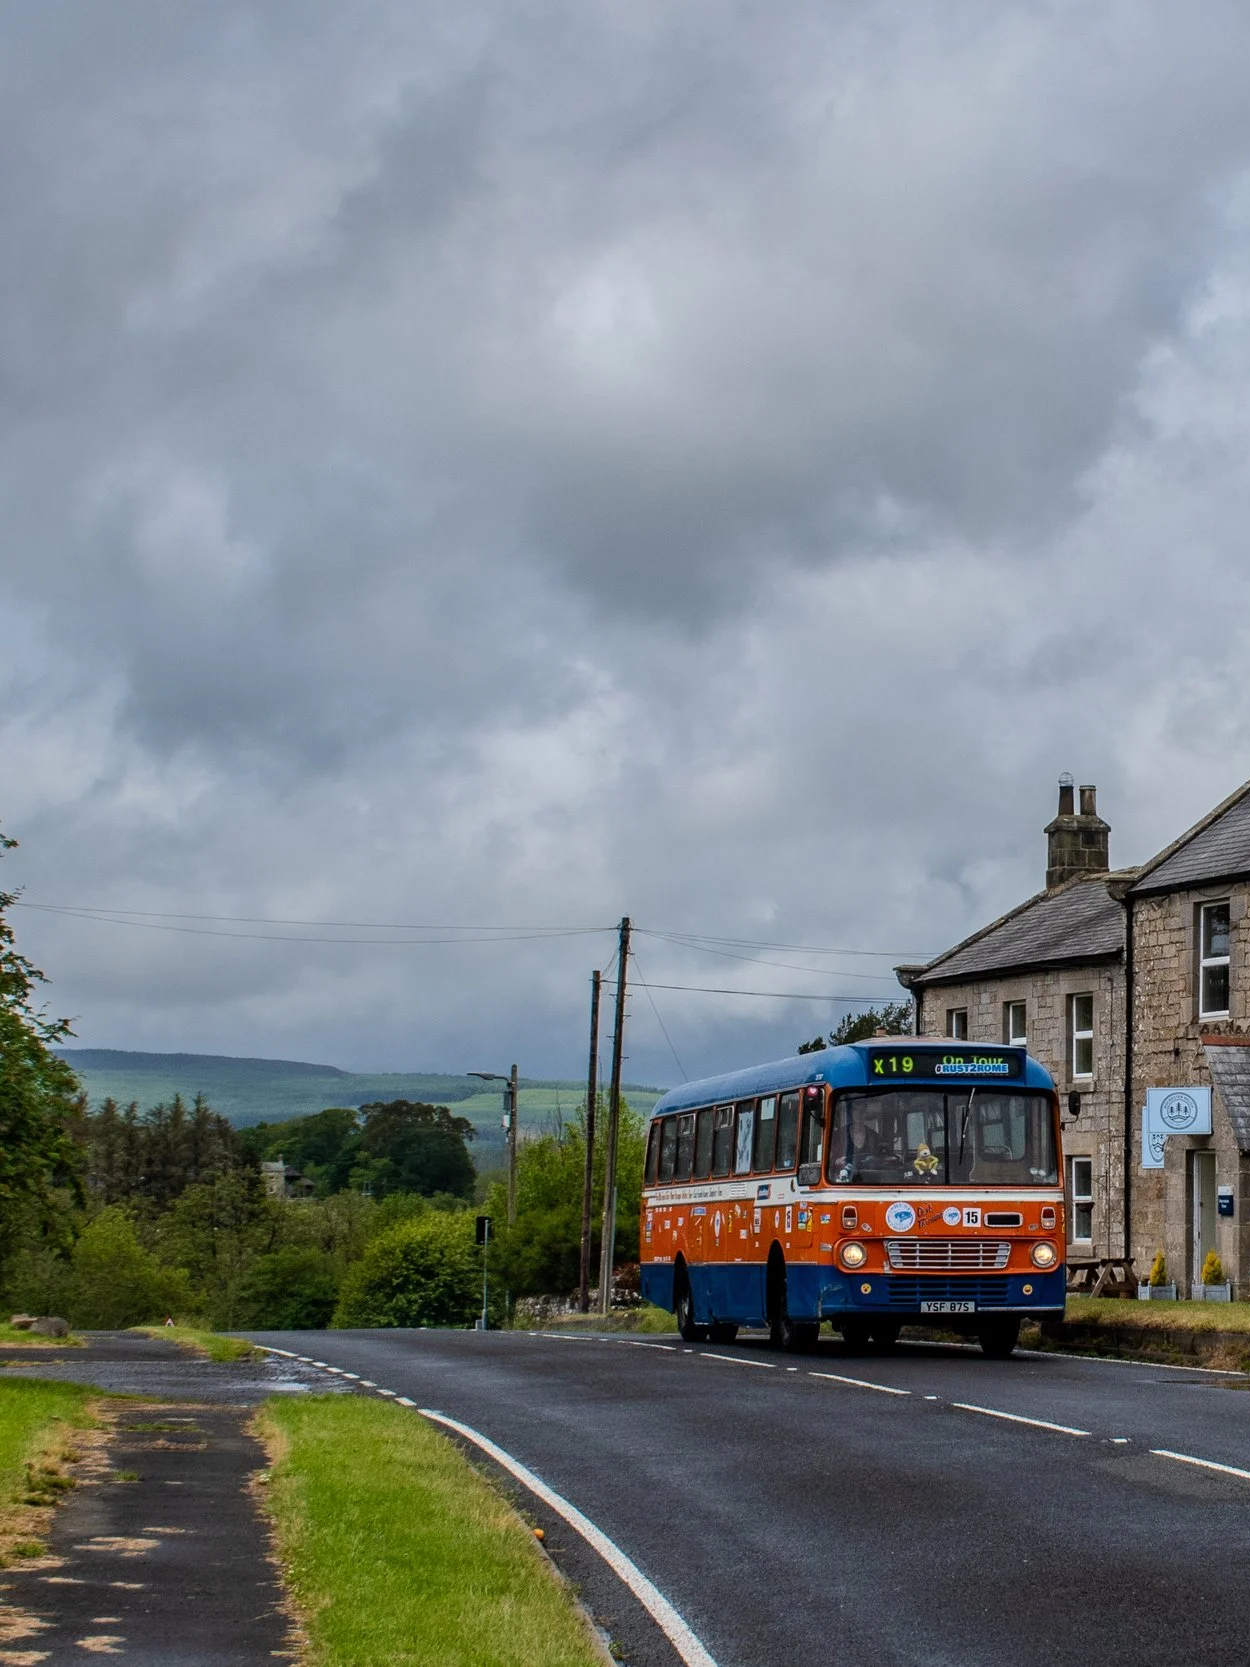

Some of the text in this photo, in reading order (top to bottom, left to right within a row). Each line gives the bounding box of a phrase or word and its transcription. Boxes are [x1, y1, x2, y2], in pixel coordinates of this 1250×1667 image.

[965, 1210, 979, 1224] 15
[926, 1302, 970, 1312] YSF 87S
